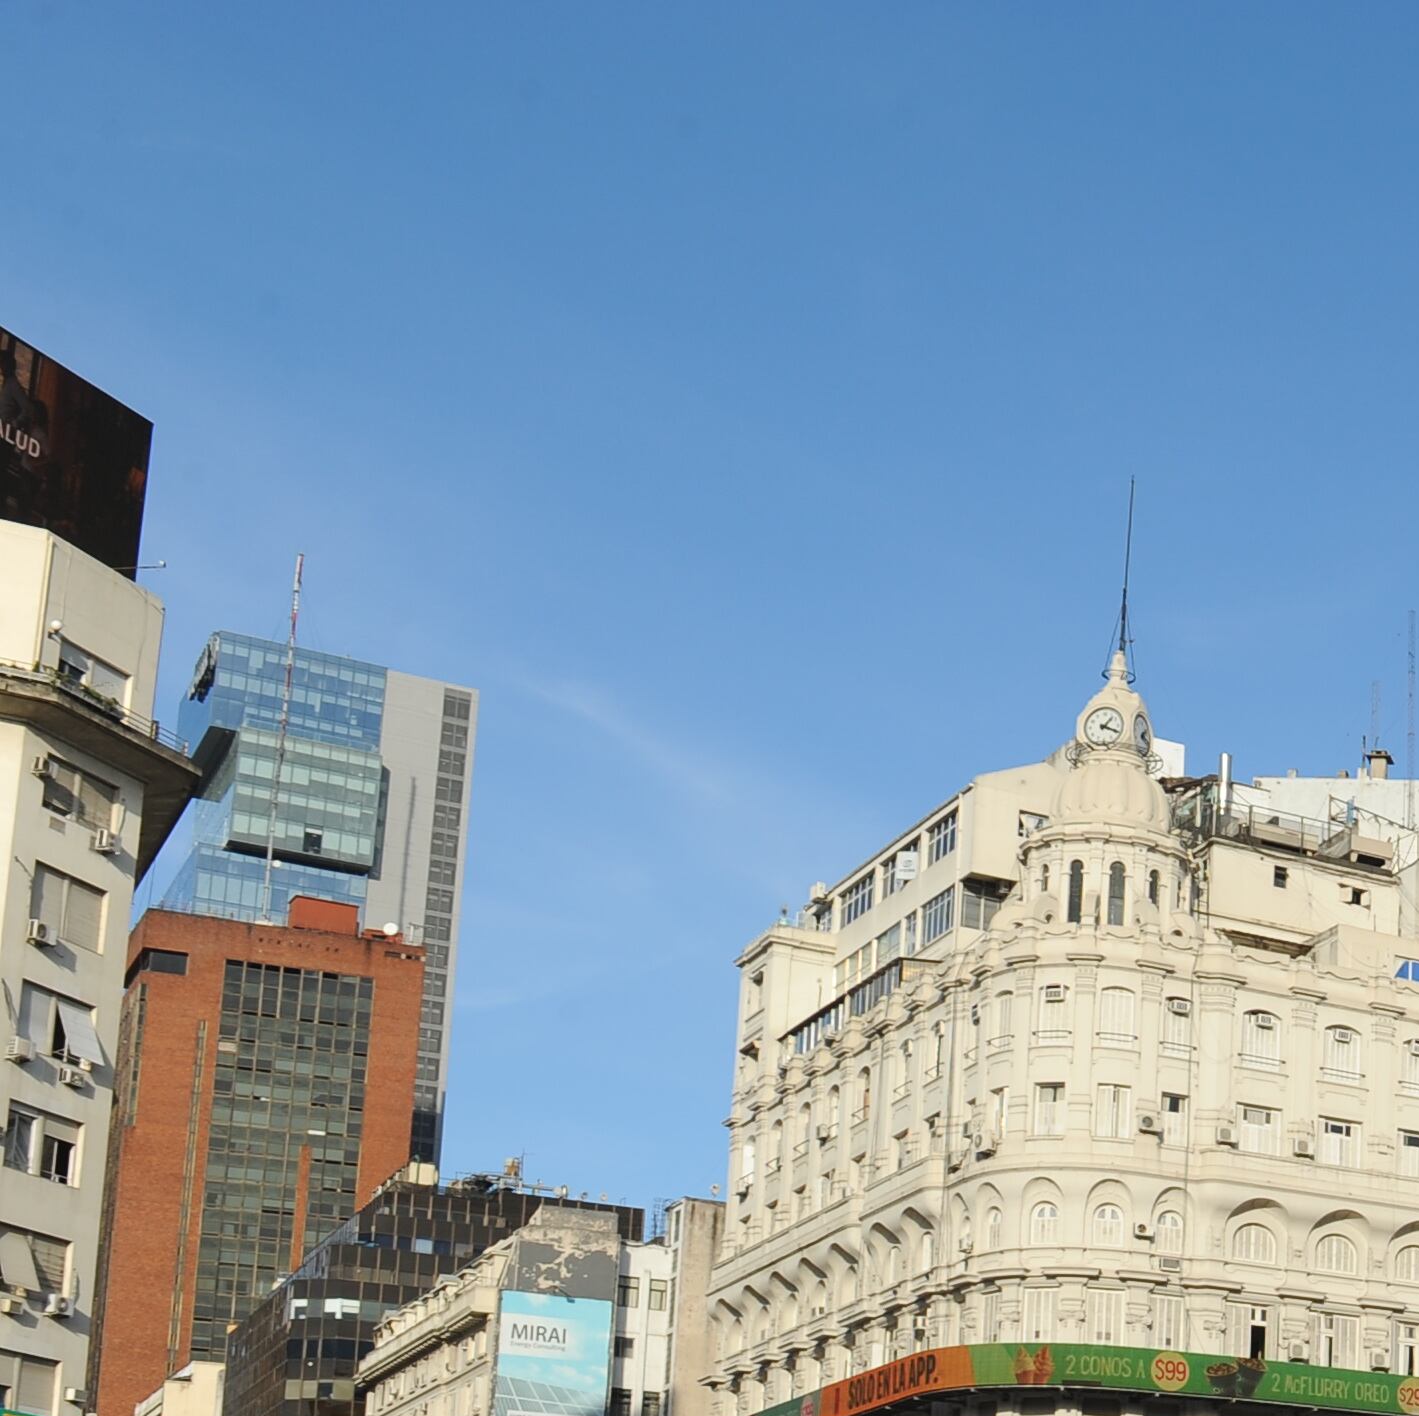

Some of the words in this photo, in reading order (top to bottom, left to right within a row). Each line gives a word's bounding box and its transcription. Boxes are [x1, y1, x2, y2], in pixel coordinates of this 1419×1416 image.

[511, 1323, 567, 1344] MIRAI
[893, 1362, 906, 1394] LA
[908, 1354, 938, 1389] APP.
[1065, 1354, 1076, 1375] 2
[1081, 1356, 1132, 1378] CONOS
[1136, 1359, 1146, 1379] A
[1155, 1358, 1187, 1381] $99
[1271, 1373, 1281, 1392] 2
[1355, 1381, 1390, 1404] OREO
